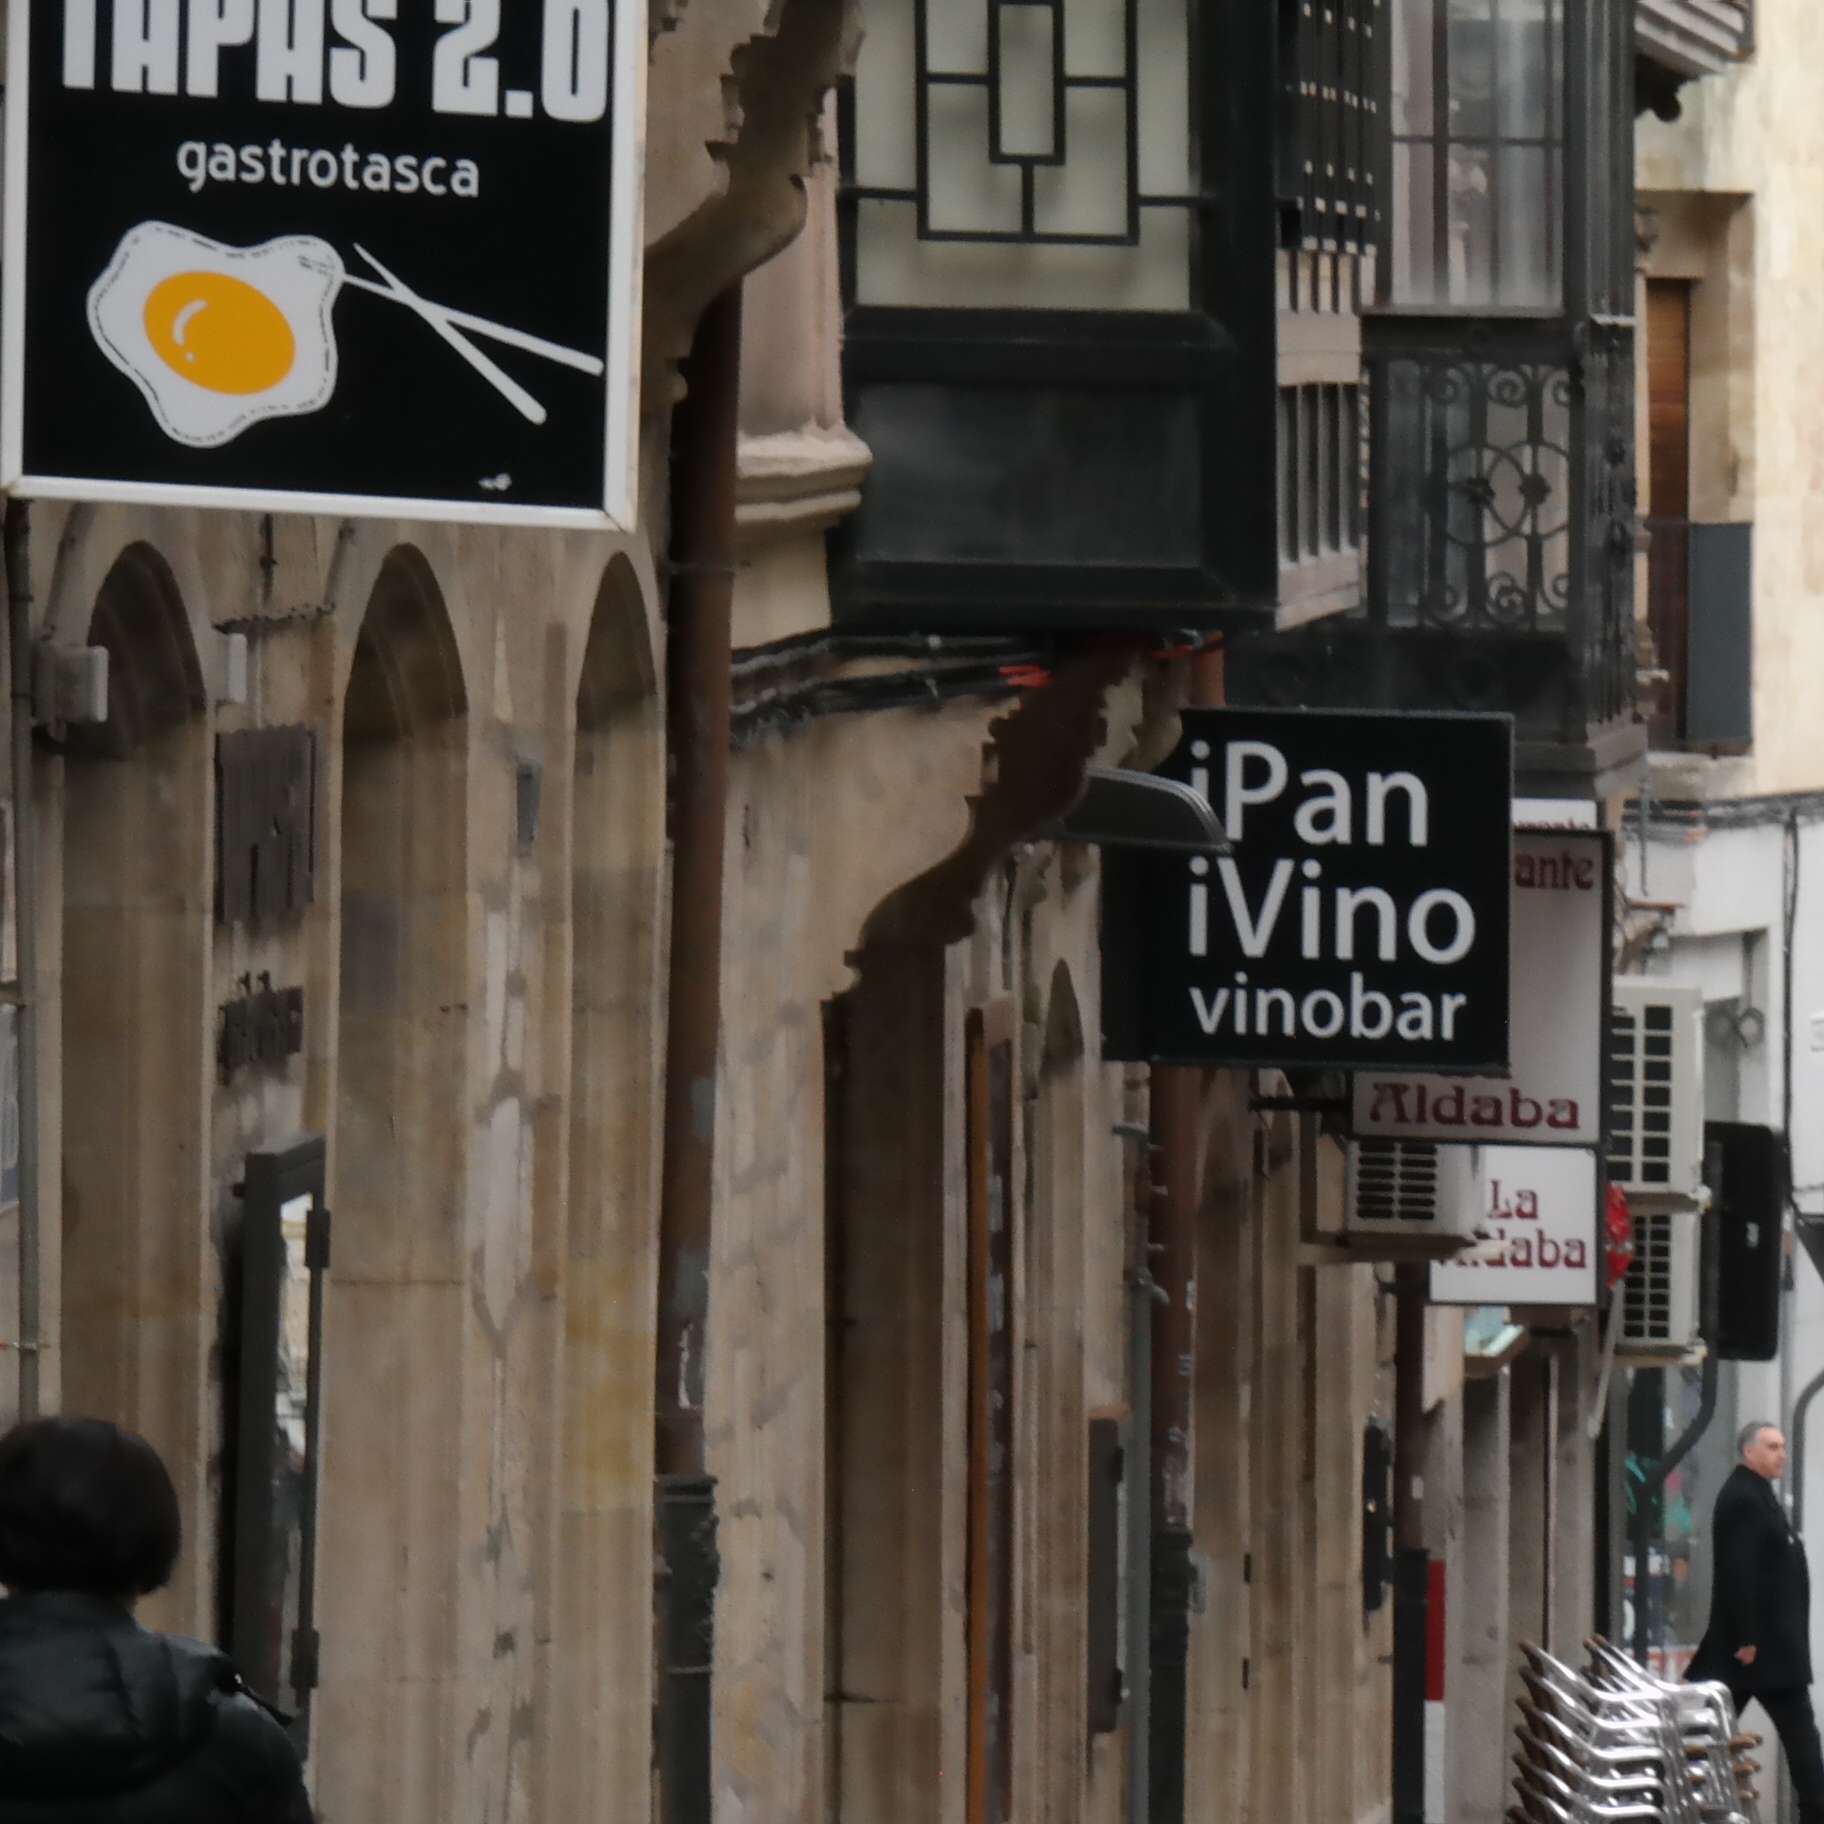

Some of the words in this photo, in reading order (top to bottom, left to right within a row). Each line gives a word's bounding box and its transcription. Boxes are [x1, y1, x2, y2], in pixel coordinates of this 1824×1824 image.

[62, 0, 397, 109] TAPAS
[432, 0, 607, 123] 2.0
[176, 138, 480, 198] gastrotasca
[1191, 739, 1428, 847] iPan
[1189, 855, 1476, 964] iVino
[1189, 970, 1467, 1041] vinobar
[1369, 1082, 1580, 1129] Aldaba
[1488, 1179, 1539, 1219] La
